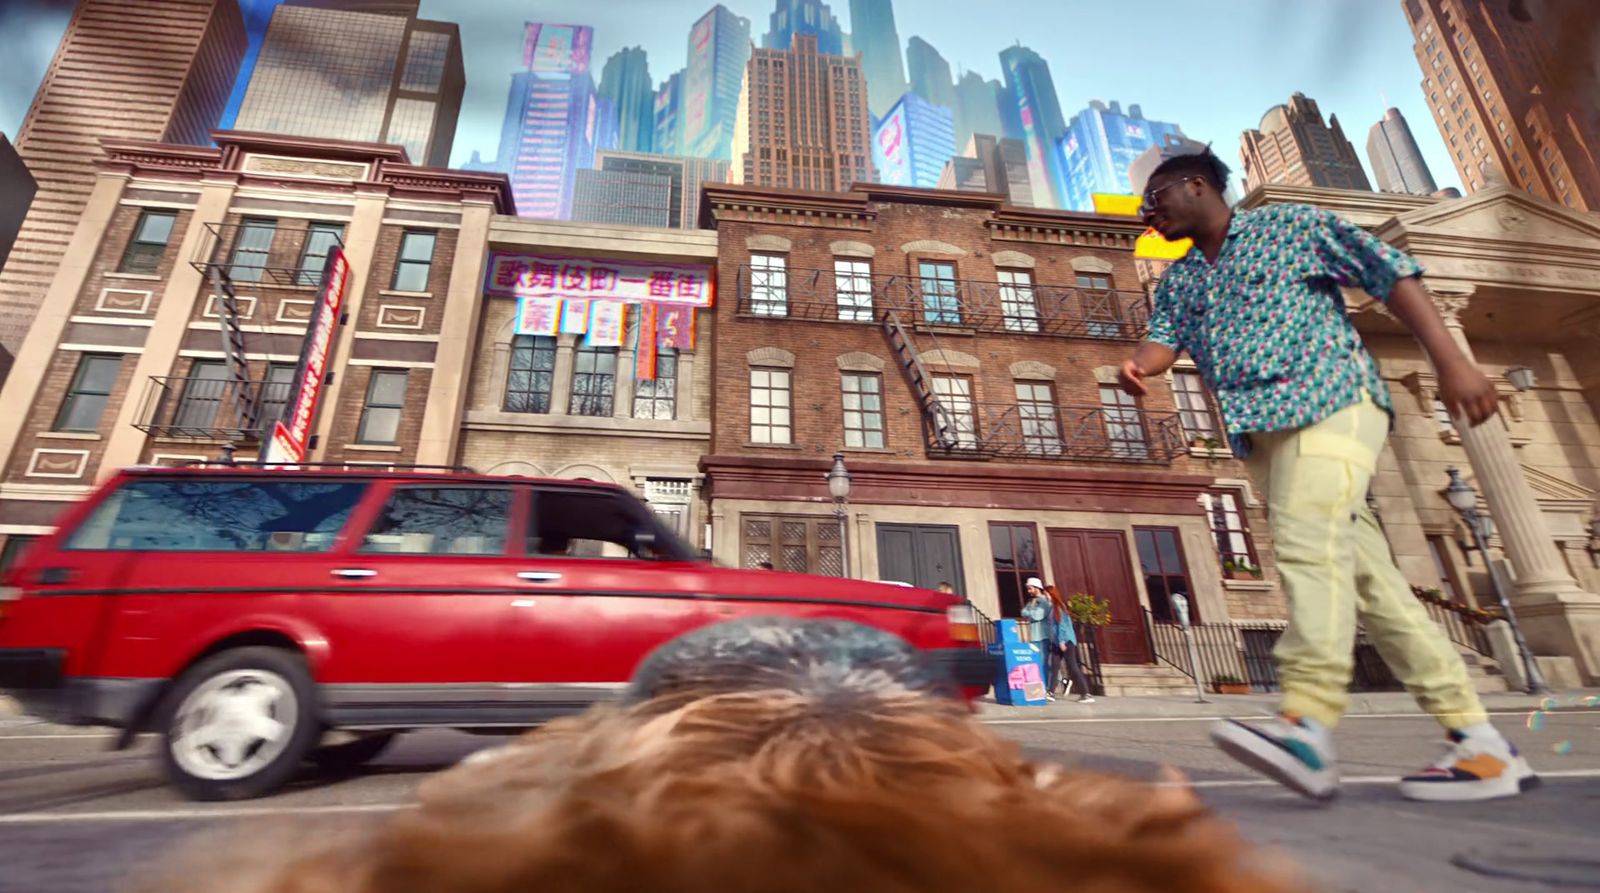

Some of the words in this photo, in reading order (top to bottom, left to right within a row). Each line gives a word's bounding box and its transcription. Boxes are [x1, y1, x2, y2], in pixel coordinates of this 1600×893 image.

[496, 258, 703, 299] 歌舞伎町一番街
